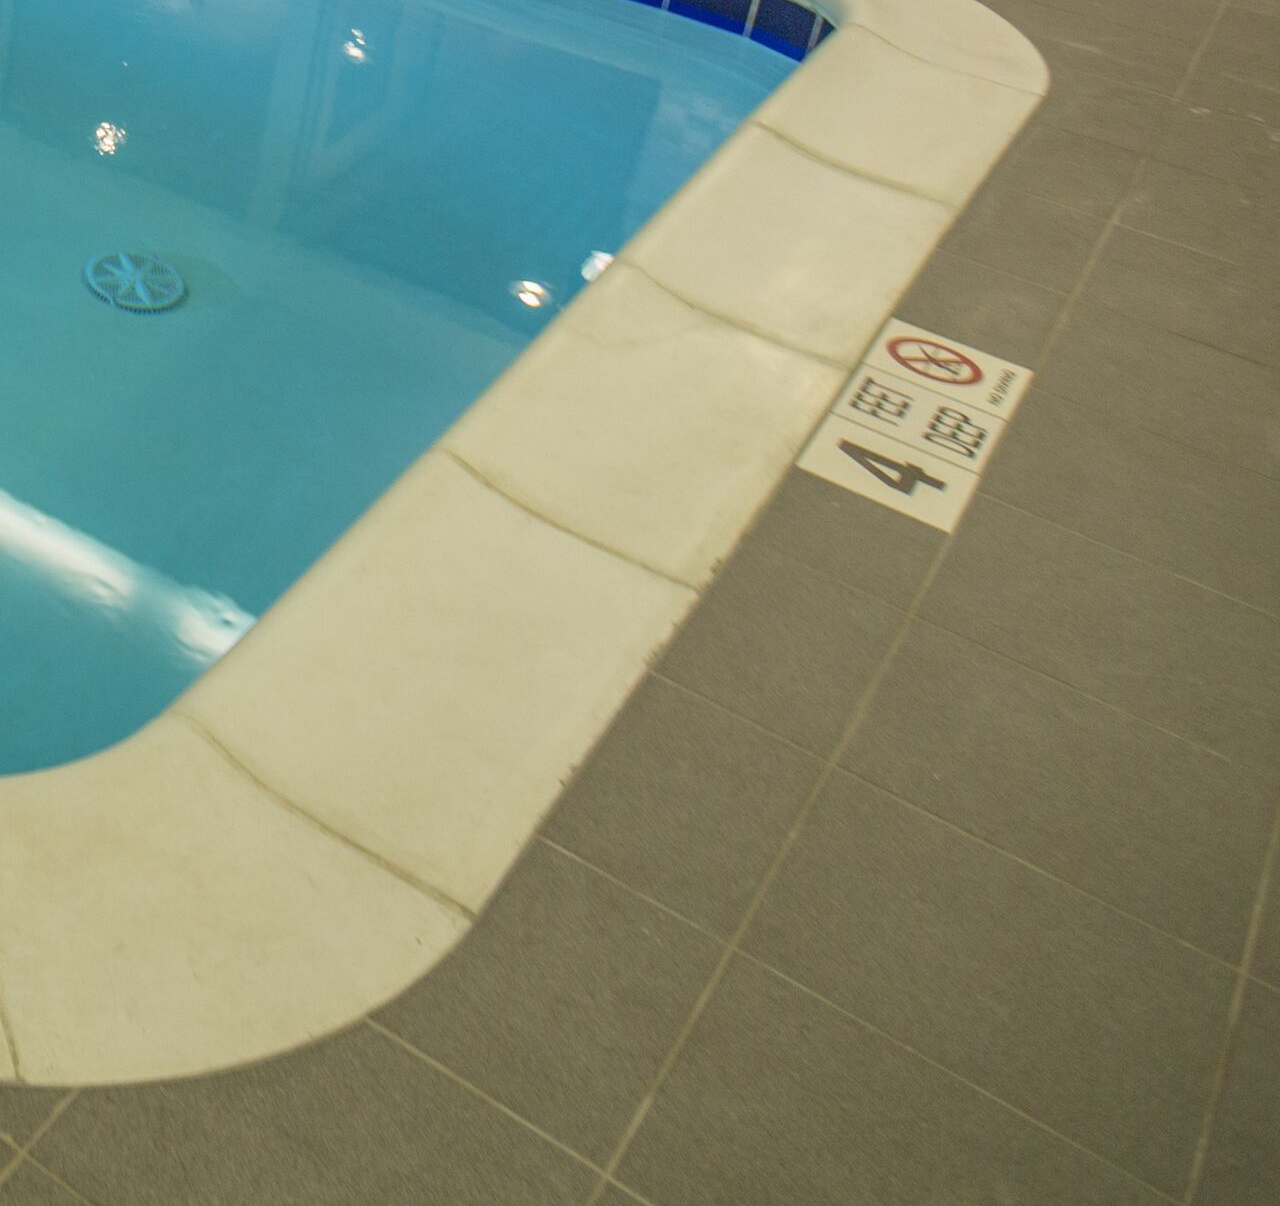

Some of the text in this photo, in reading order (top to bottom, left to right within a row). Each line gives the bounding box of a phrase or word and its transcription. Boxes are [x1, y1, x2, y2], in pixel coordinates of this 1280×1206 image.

[848, 376, 915, 427] FEET
[922, 406, 987, 460] DEEP
[837, 439, 946, 495] 4
